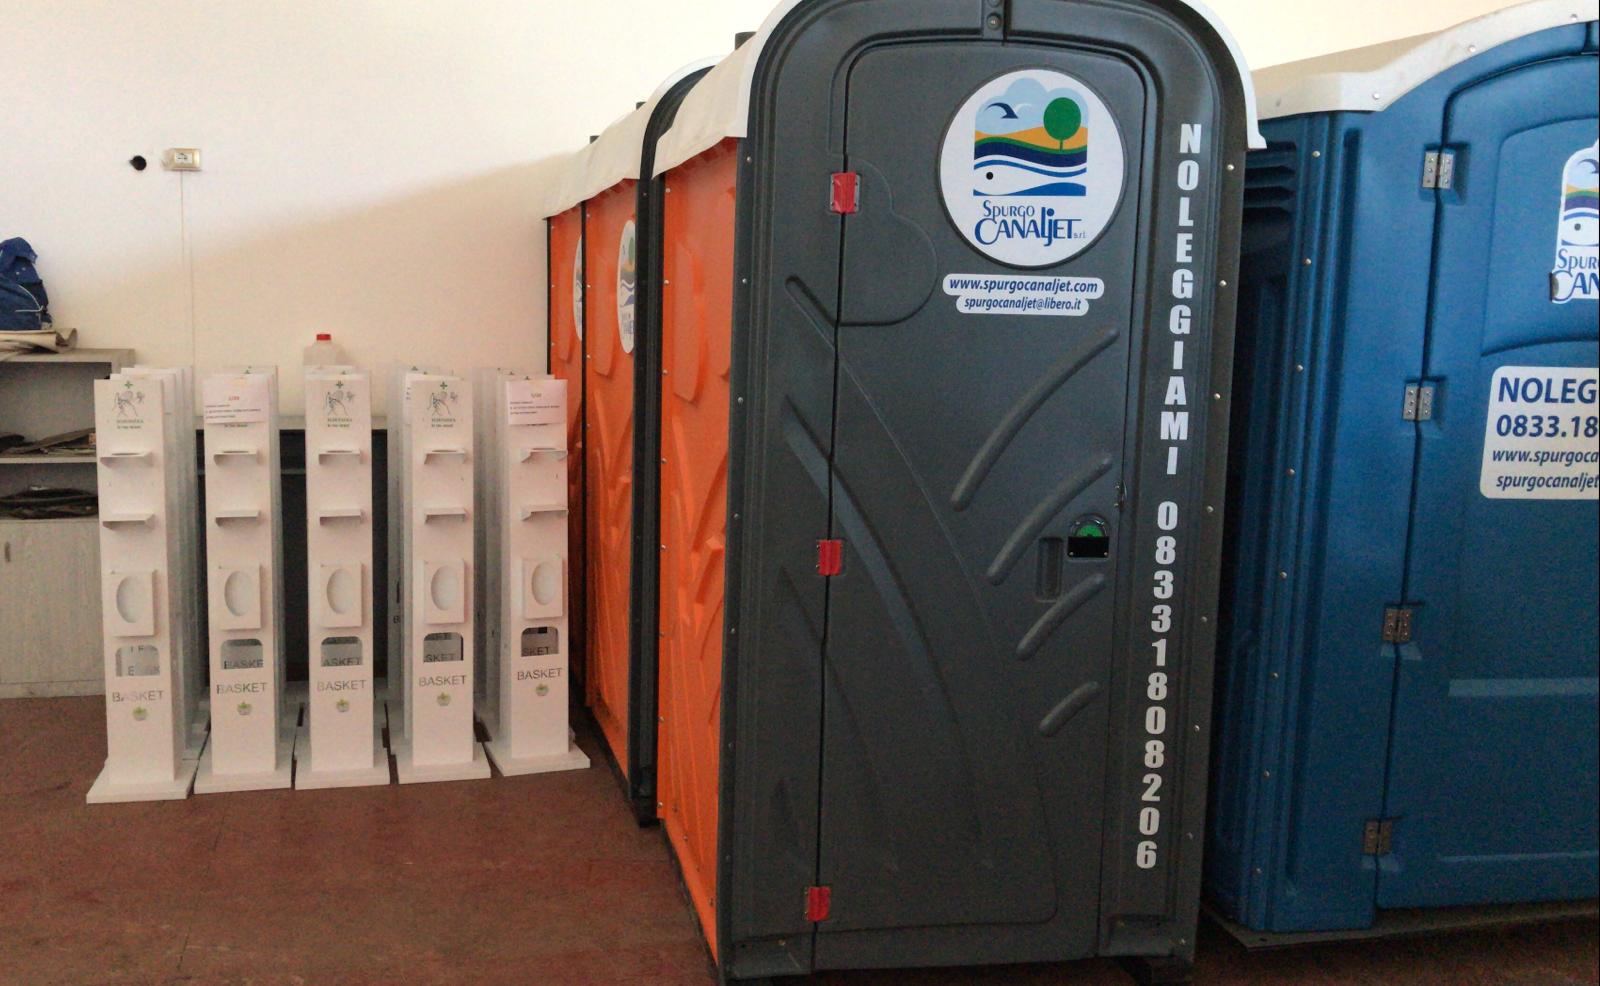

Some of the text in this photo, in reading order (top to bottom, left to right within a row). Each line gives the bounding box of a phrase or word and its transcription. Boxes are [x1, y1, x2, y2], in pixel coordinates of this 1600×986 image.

[1557, 248, 1598, 272] SPUR
[949, 277, 1098, 295] www.spurgocanaljet.com
[964, 296, 1082, 312] spurgocanaljet@libero.it
[1160, 123, 1202, 475] NOLEGGIAMI
[1498, 377, 1598, 404] NOLEG
[1496, 414, 1599, 438] 0833.18
[419, 675, 466, 687] BASKET
[517, 667, 563, 680] BASKET
[216, 682, 268, 694] BASKET
[316, 679, 367, 691] BASKET
[1136, 501, 1179, 870] 08331808206
